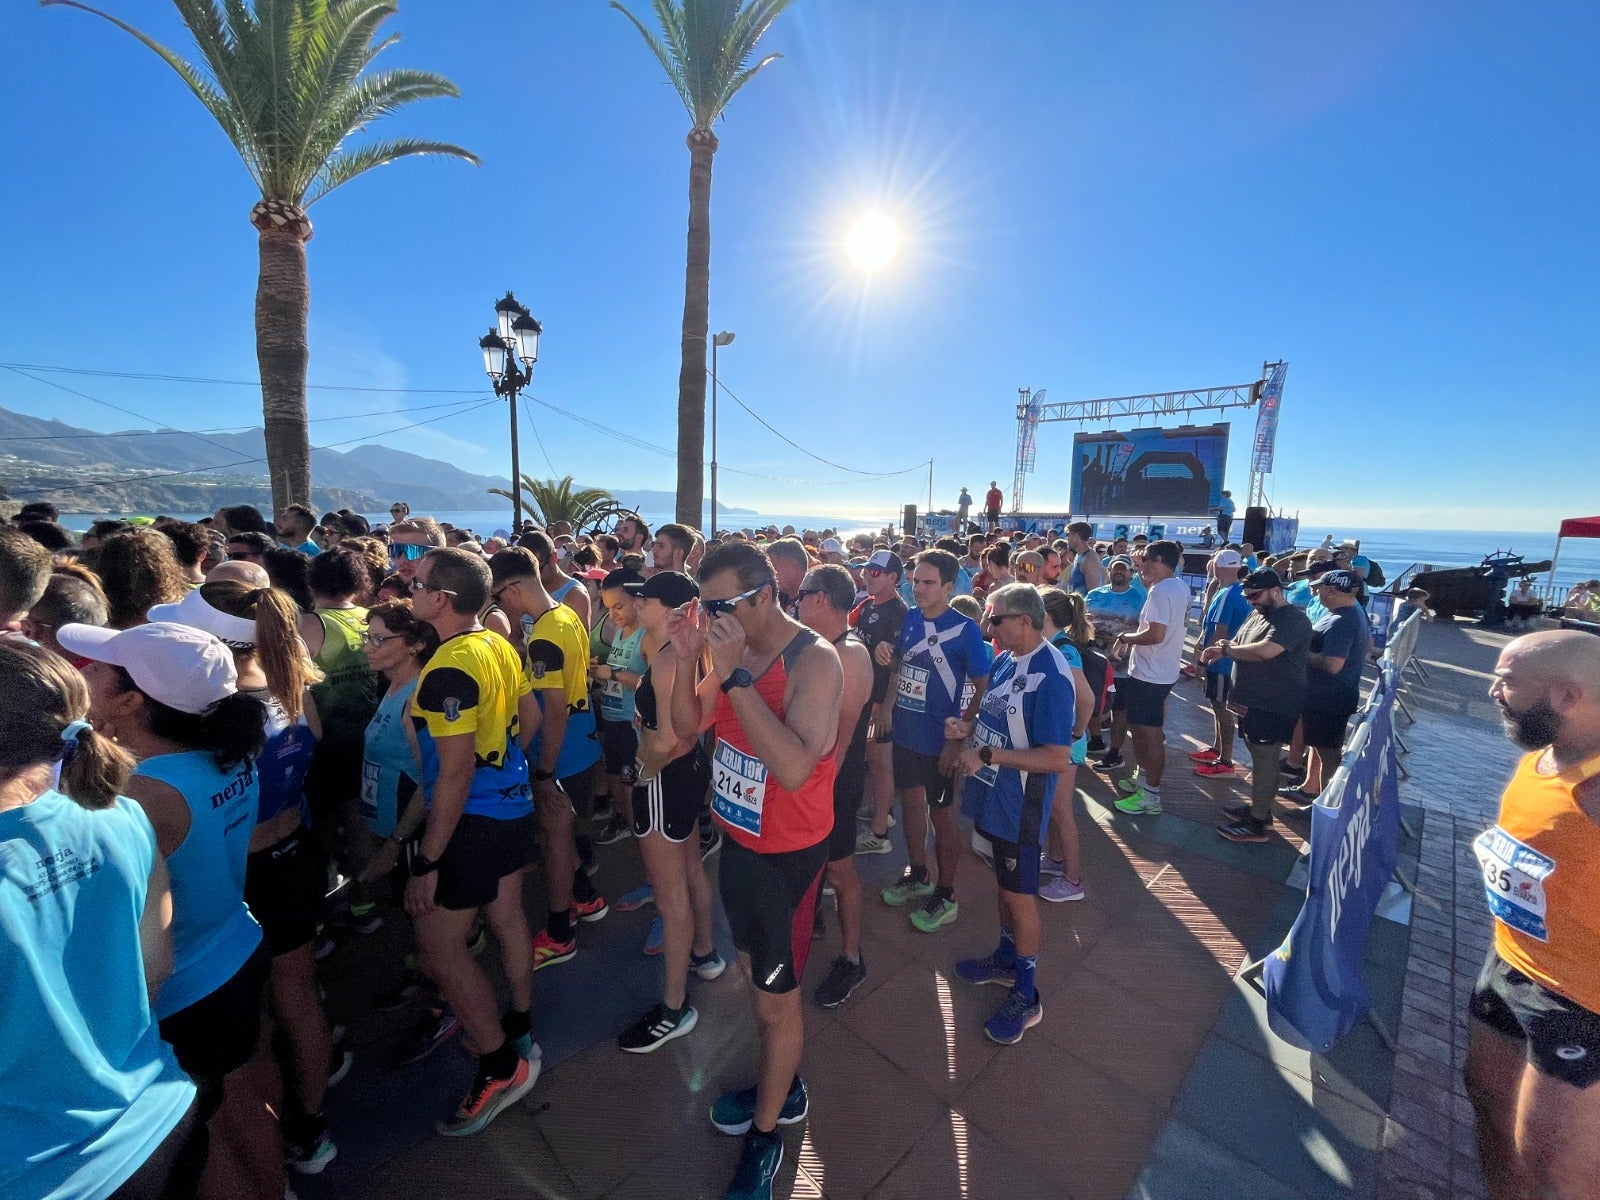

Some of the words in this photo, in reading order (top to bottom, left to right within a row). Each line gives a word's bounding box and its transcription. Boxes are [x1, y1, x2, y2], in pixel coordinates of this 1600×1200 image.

[1115, 524, 1128, 539] 3
[1149, 525, 1163, 541] 5
[914, 669, 928, 684] 10K
[721, 746, 743, 774] NERJA
[743, 759, 764, 782] 10K
[209, 772, 254, 810] nerja
[717, 770, 742, 799] 214
[1328, 782, 1373, 944] nerja
